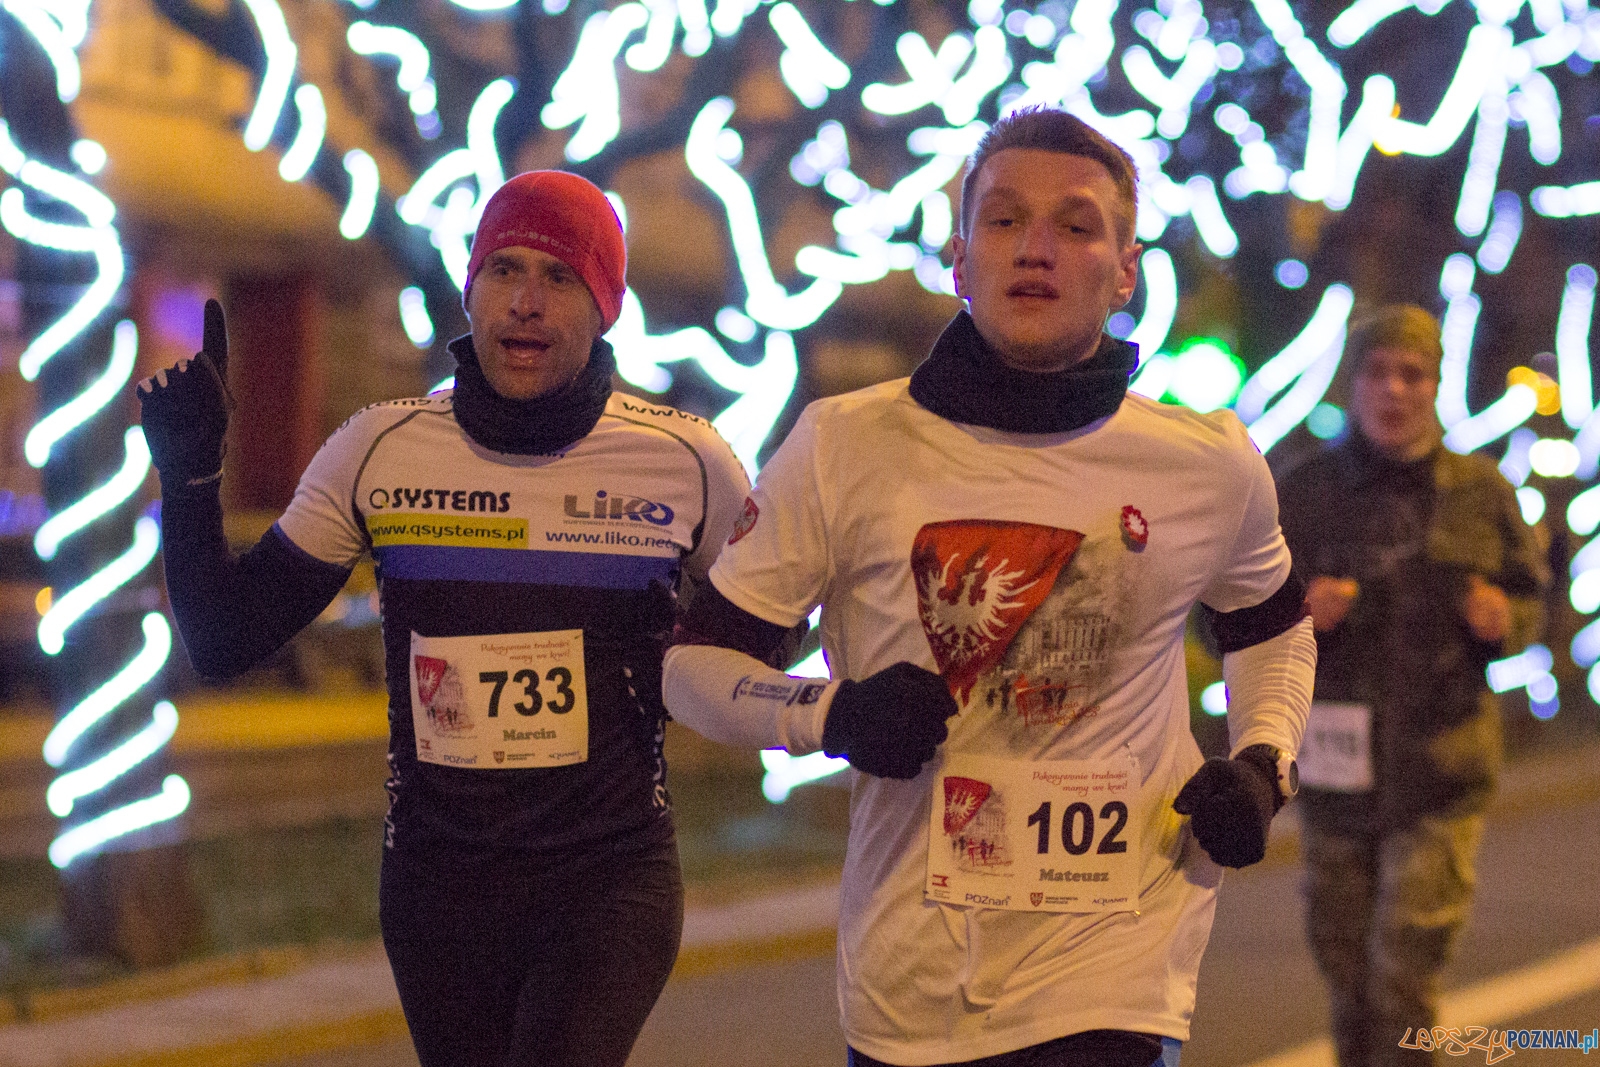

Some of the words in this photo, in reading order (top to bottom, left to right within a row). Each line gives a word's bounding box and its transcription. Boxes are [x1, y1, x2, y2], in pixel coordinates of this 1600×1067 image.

[371, 523, 525, 541] www.qsystems.pl
[479, 666, 576, 718] 733
[502, 728, 557, 742] Marcin
[1062, 785, 1089, 798] mamy
[1027, 801, 1129, 856] 102
[1038, 868, 1110, 883] Mateusz
